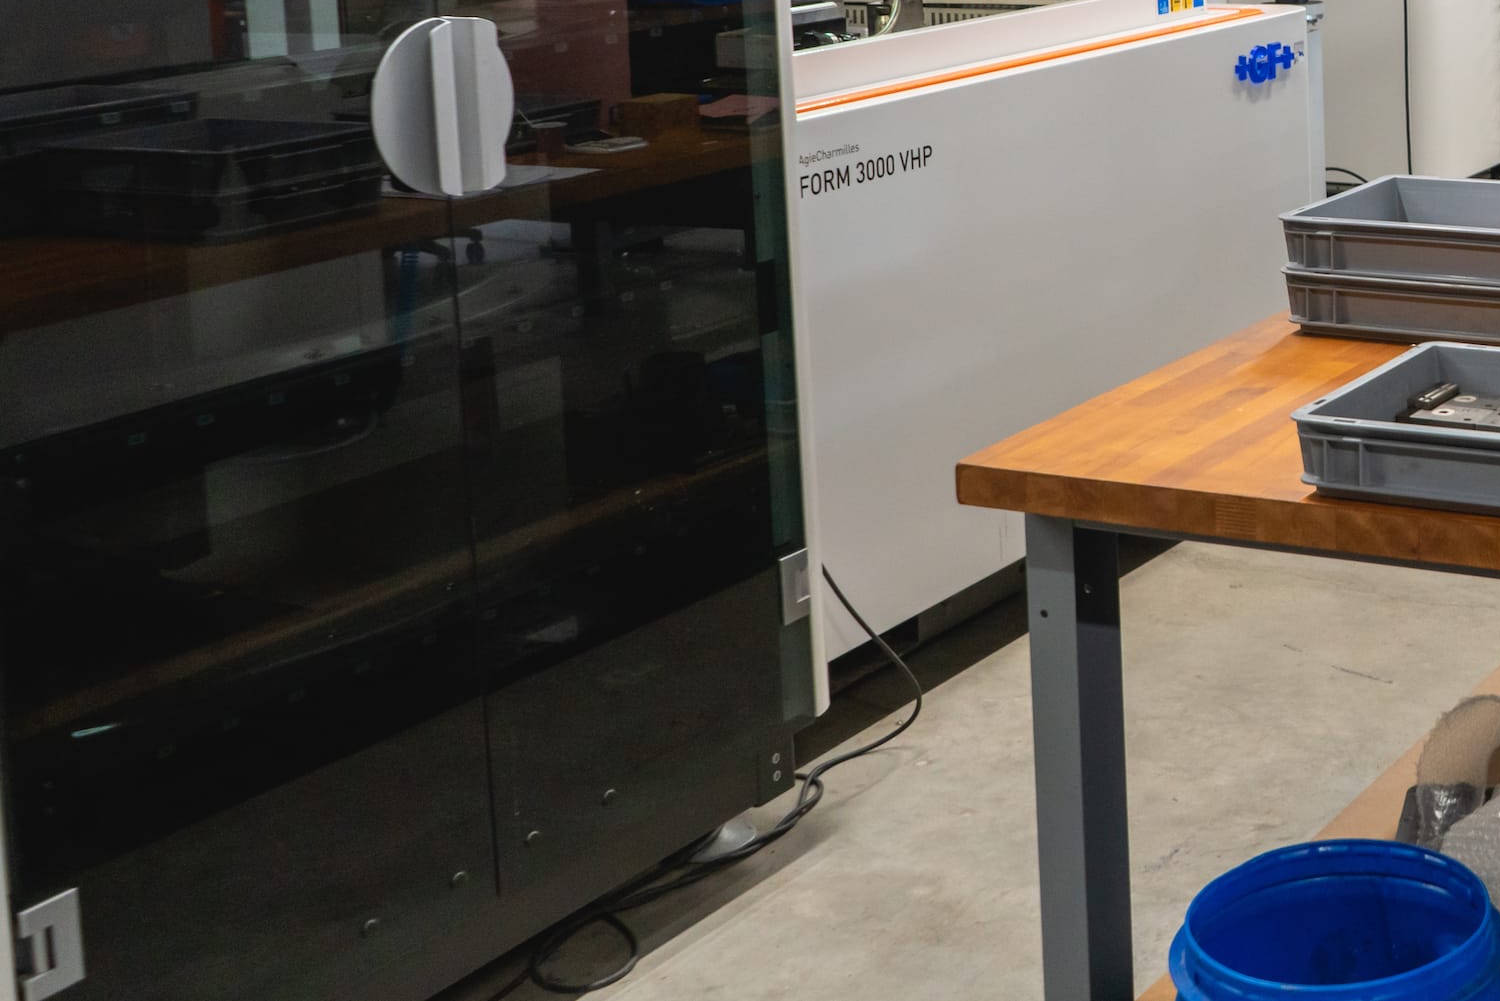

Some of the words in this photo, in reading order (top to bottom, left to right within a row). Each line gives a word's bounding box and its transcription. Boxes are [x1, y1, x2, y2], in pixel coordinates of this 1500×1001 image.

[798, 143, 860, 168] AgieCharmilles
[799, 164, 850, 199] FORM
[855, 153, 895, 184] 3000
[899, 144, 933, 173] VHP
